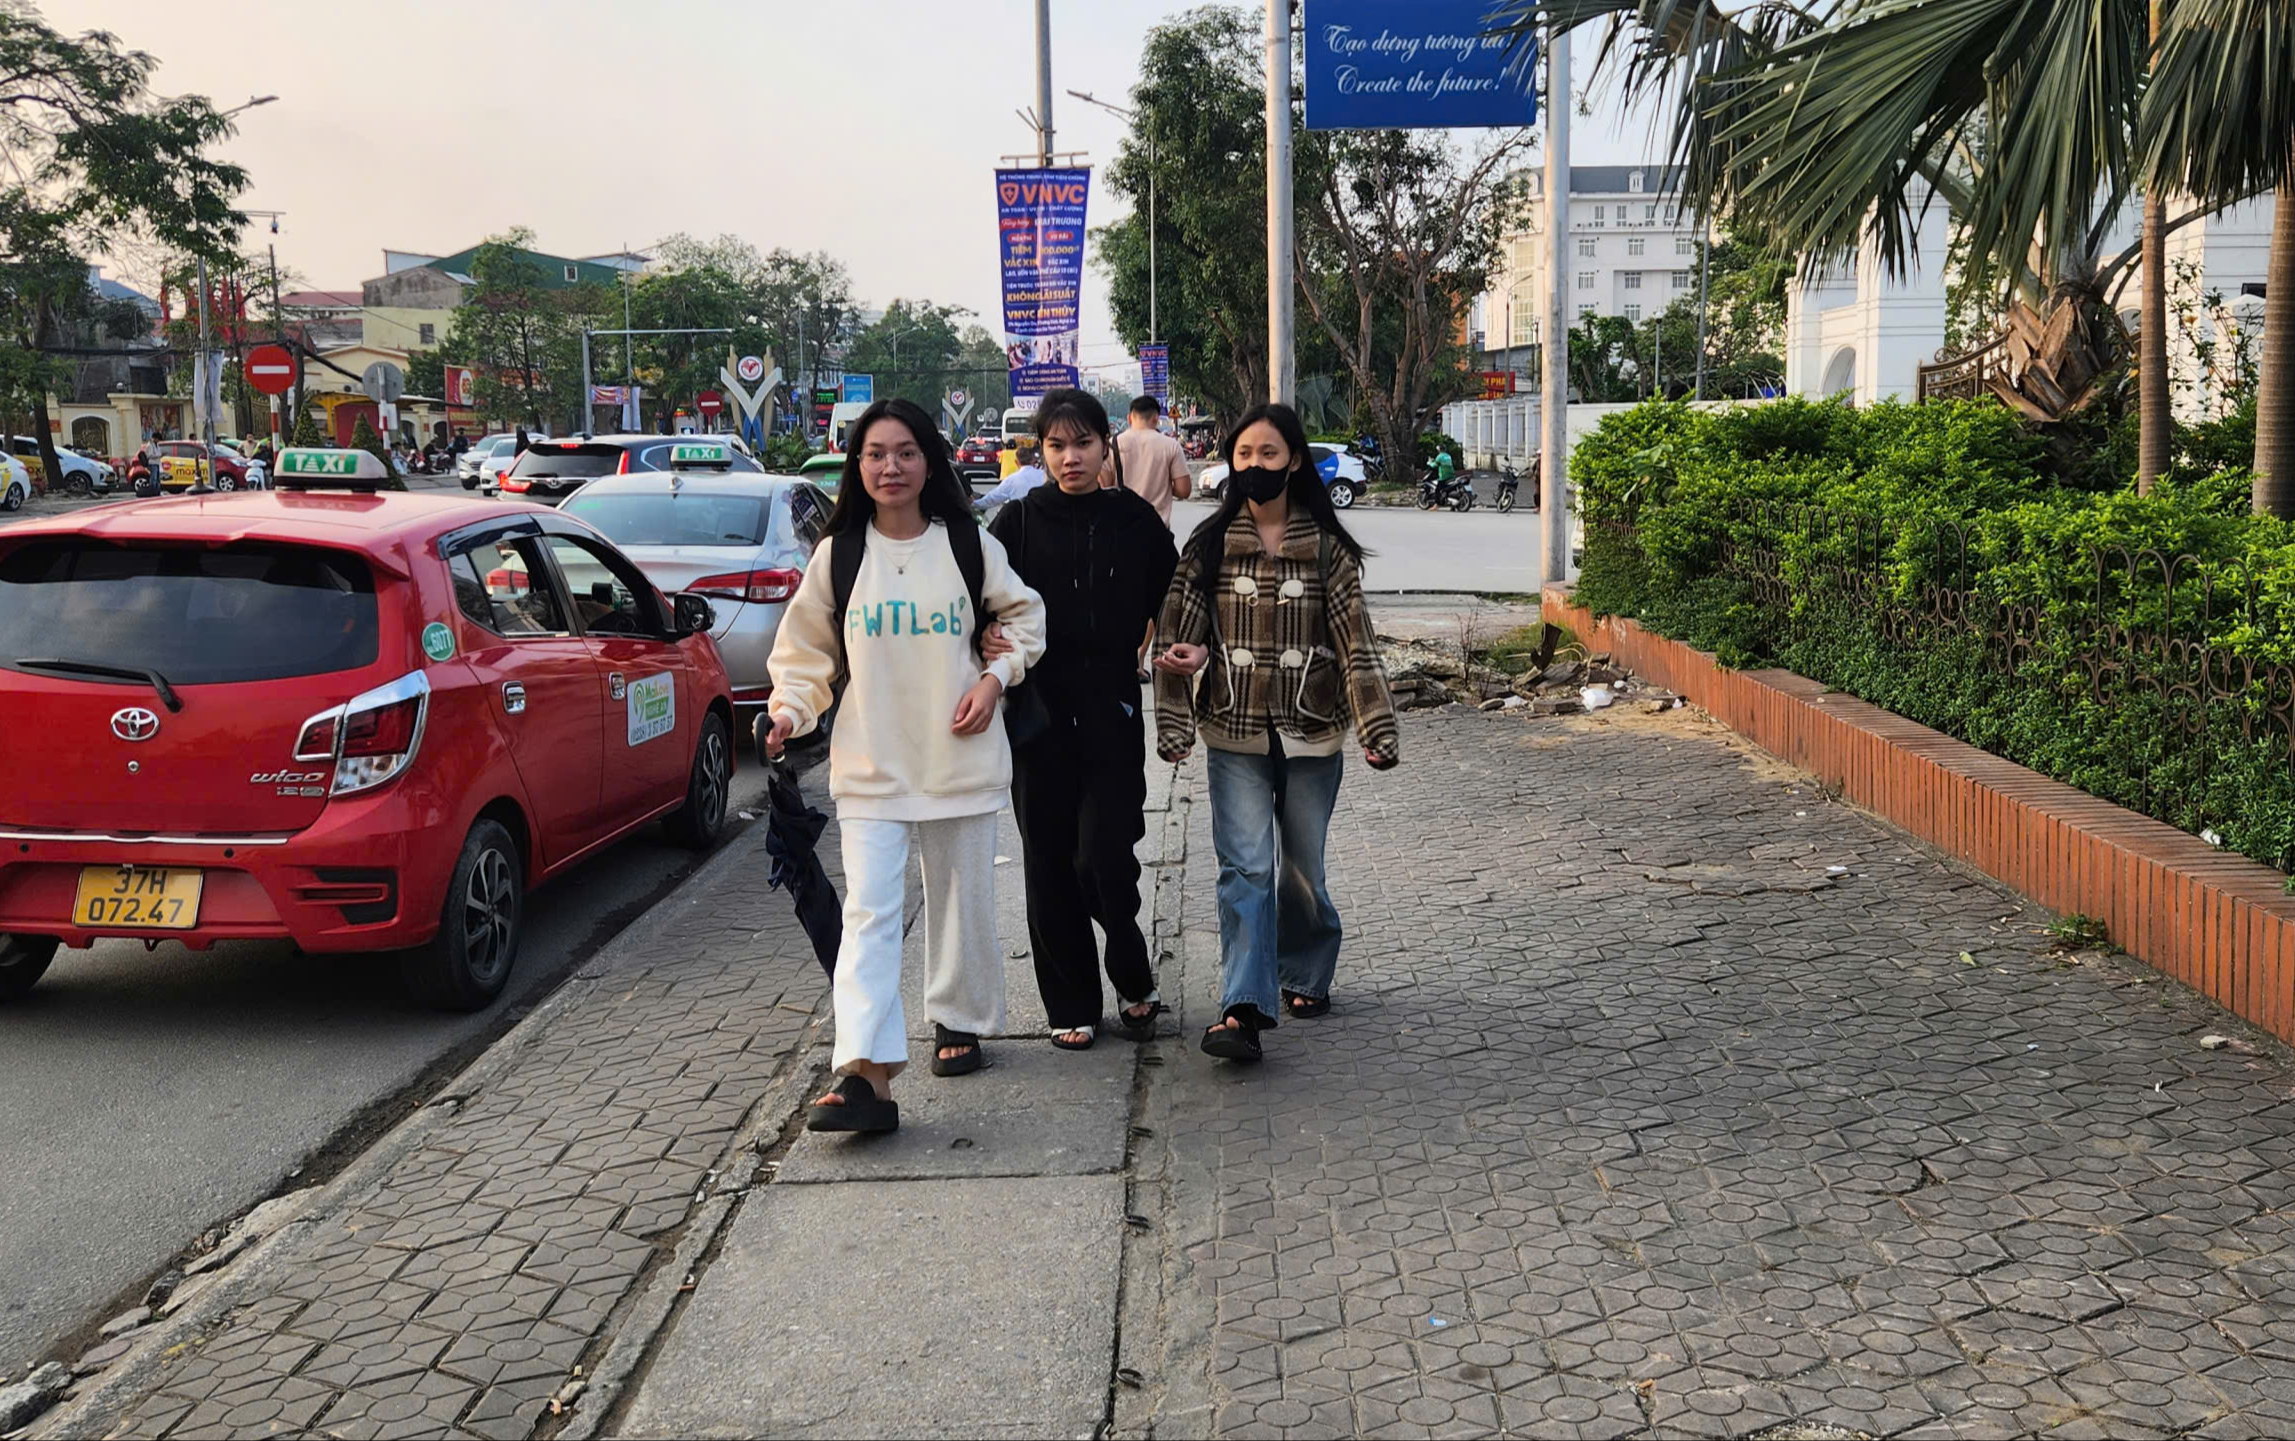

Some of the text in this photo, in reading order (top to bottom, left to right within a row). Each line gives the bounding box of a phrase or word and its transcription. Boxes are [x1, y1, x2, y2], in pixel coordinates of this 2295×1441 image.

[1323, 24, 1367, 58] Tạo
[1371, 29, 1421, 63] dựng
[1334, 65, 1508, 101] Create the future!
[1021, 183, 1085, 204] VNVC
[1006, 291, 1041, 302] KHÔNG
[1053, 286, 1076, 299] SUẤT
[1006, 309, 1036, 319] VNVC
[848, 600, 962, 643] FWTLab
[113, 867, 168, 894] 37H
[88, 897, 184, 922] 072.47
